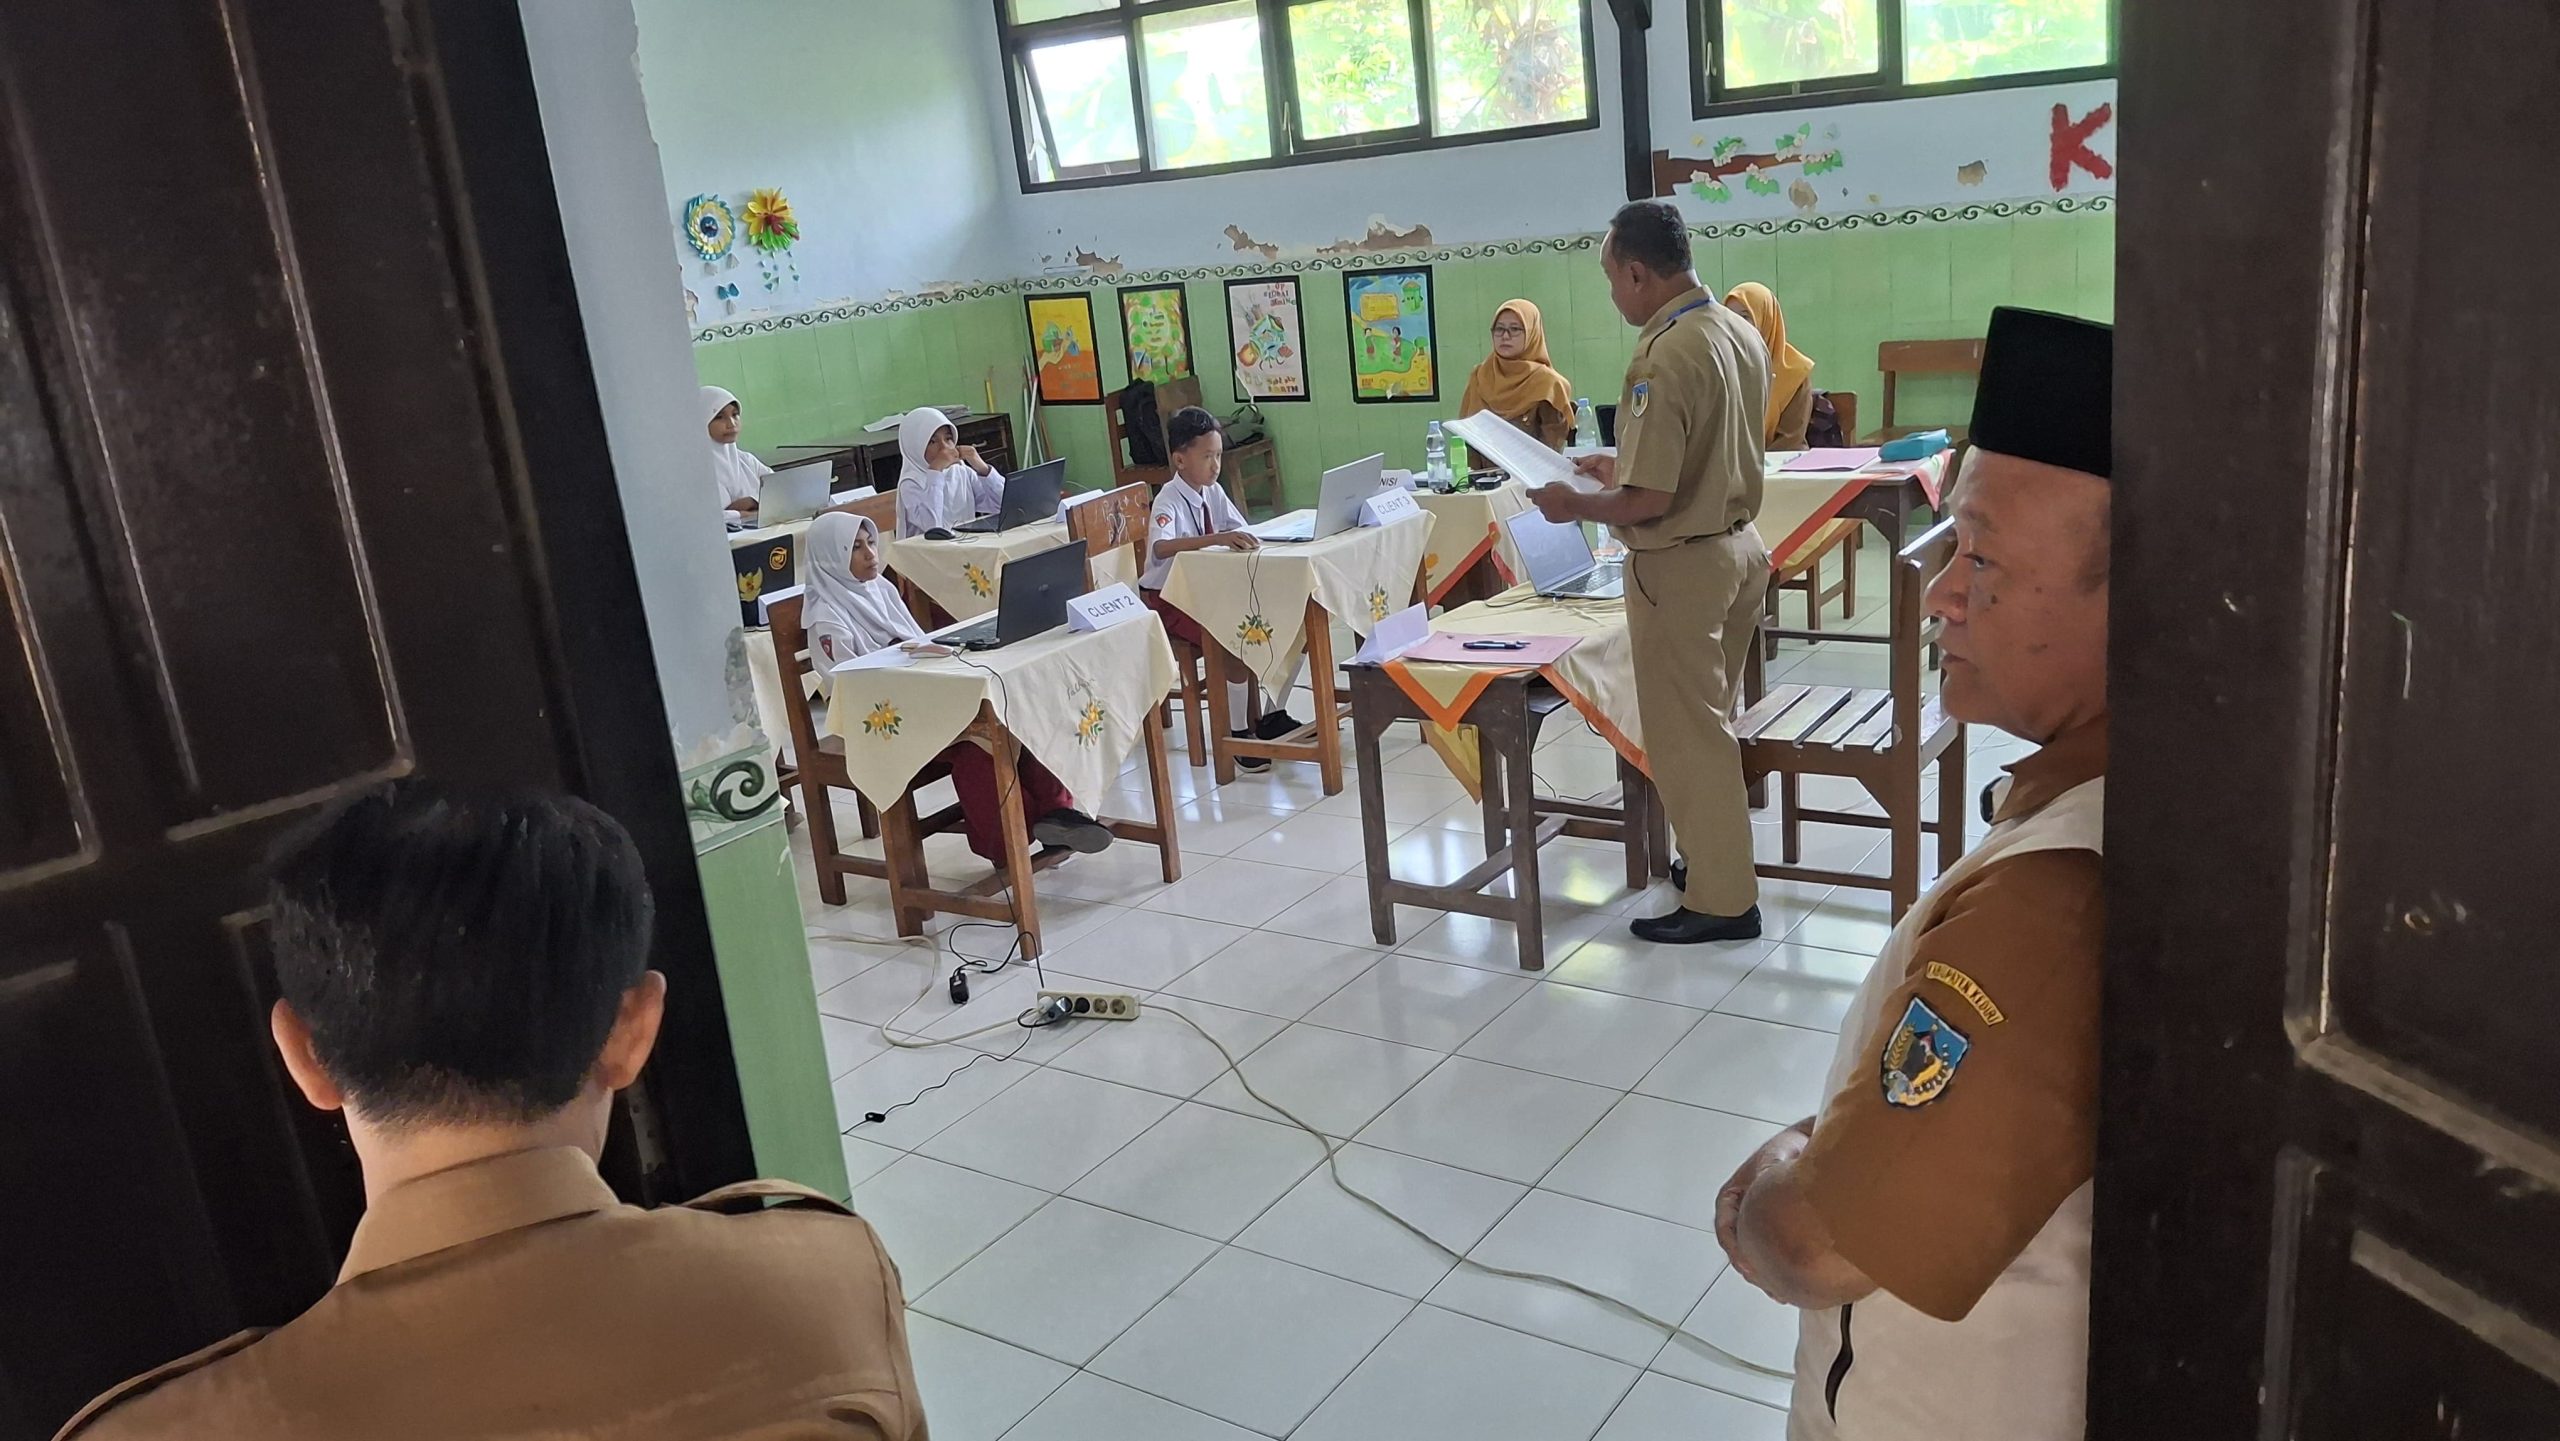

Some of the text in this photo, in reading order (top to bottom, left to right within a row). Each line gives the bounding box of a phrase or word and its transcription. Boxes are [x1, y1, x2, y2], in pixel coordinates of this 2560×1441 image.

[2049, 102, 2112, 193] K
[1377, 495, 1411, 515] CLIENT 3
[1087, 595, 1135, 618] CLIENT 2
[1969, 989, 2001, 1023] KEDIRI
